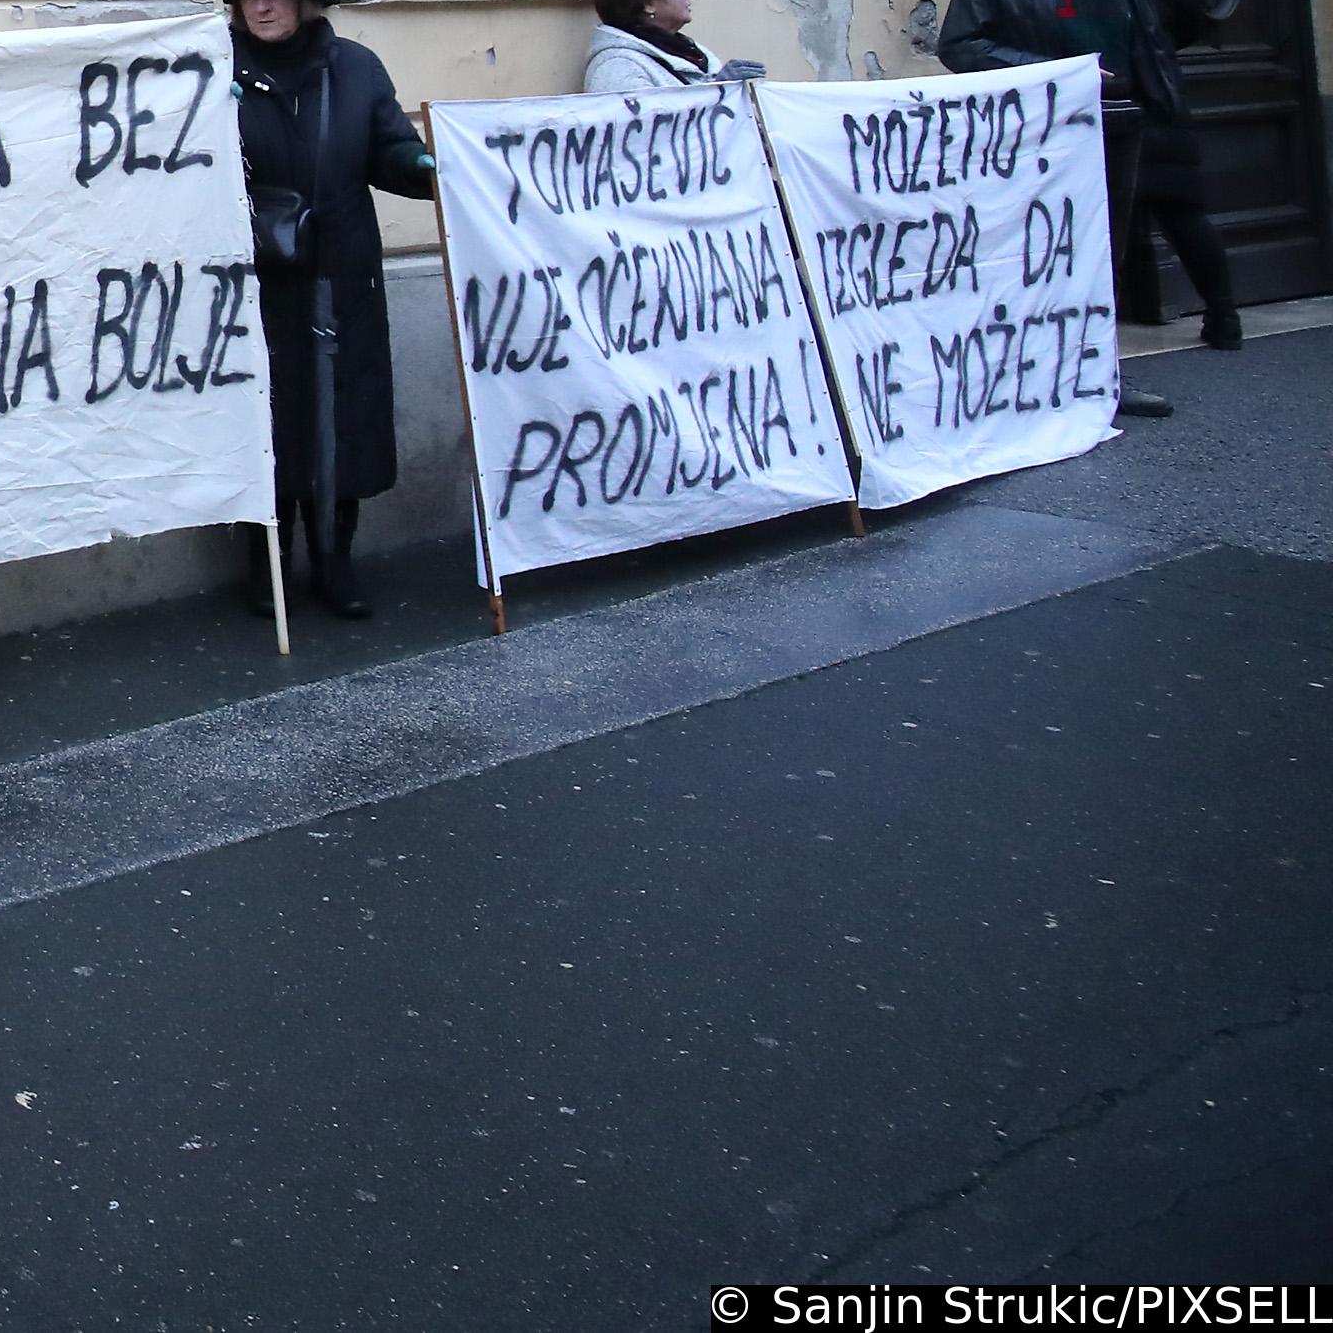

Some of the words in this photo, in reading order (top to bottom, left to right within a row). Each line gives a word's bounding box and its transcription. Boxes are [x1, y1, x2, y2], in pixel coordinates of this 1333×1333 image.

[75, 52, 214, 188] BEZ
[485, 85, 735, 224] TOMAŠEVIĆ
[463, 266, 571, 374] NIJE
[817, 203, 981, 320] IZGLEDA
[1022, 197, 1075, 288] DA
[84, 260, 256, 404] BOLJE
[855, 342, 906, 448] NE
